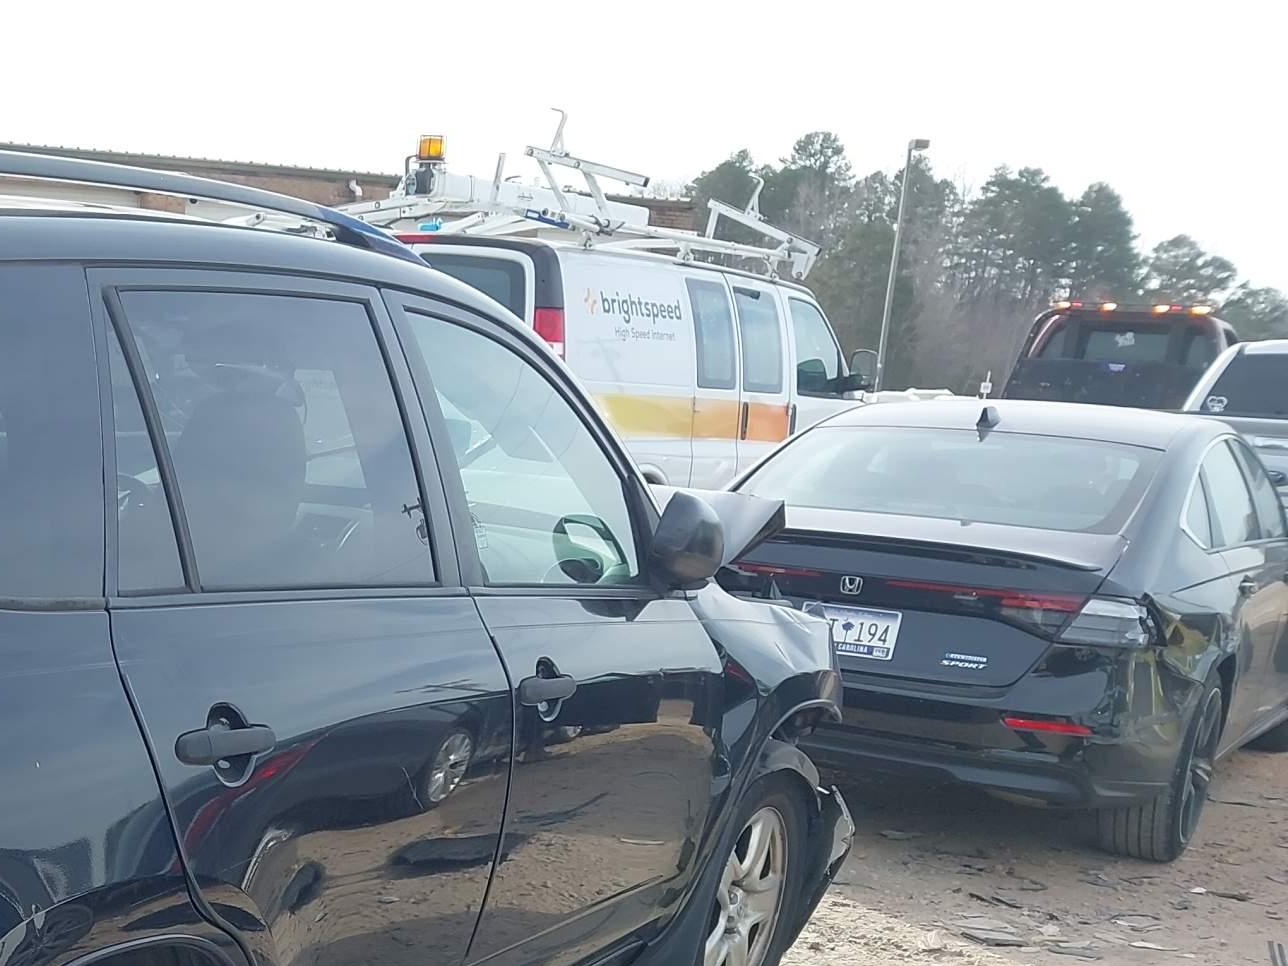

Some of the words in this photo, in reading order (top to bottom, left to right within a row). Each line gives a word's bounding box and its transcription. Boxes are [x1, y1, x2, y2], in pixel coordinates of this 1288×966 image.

[600, 290, 682, 324] brightspeed
[614, 326, 630, 341] High
[631, 327, 650, 341] Speed
[854, 621, 890, 645] 194
